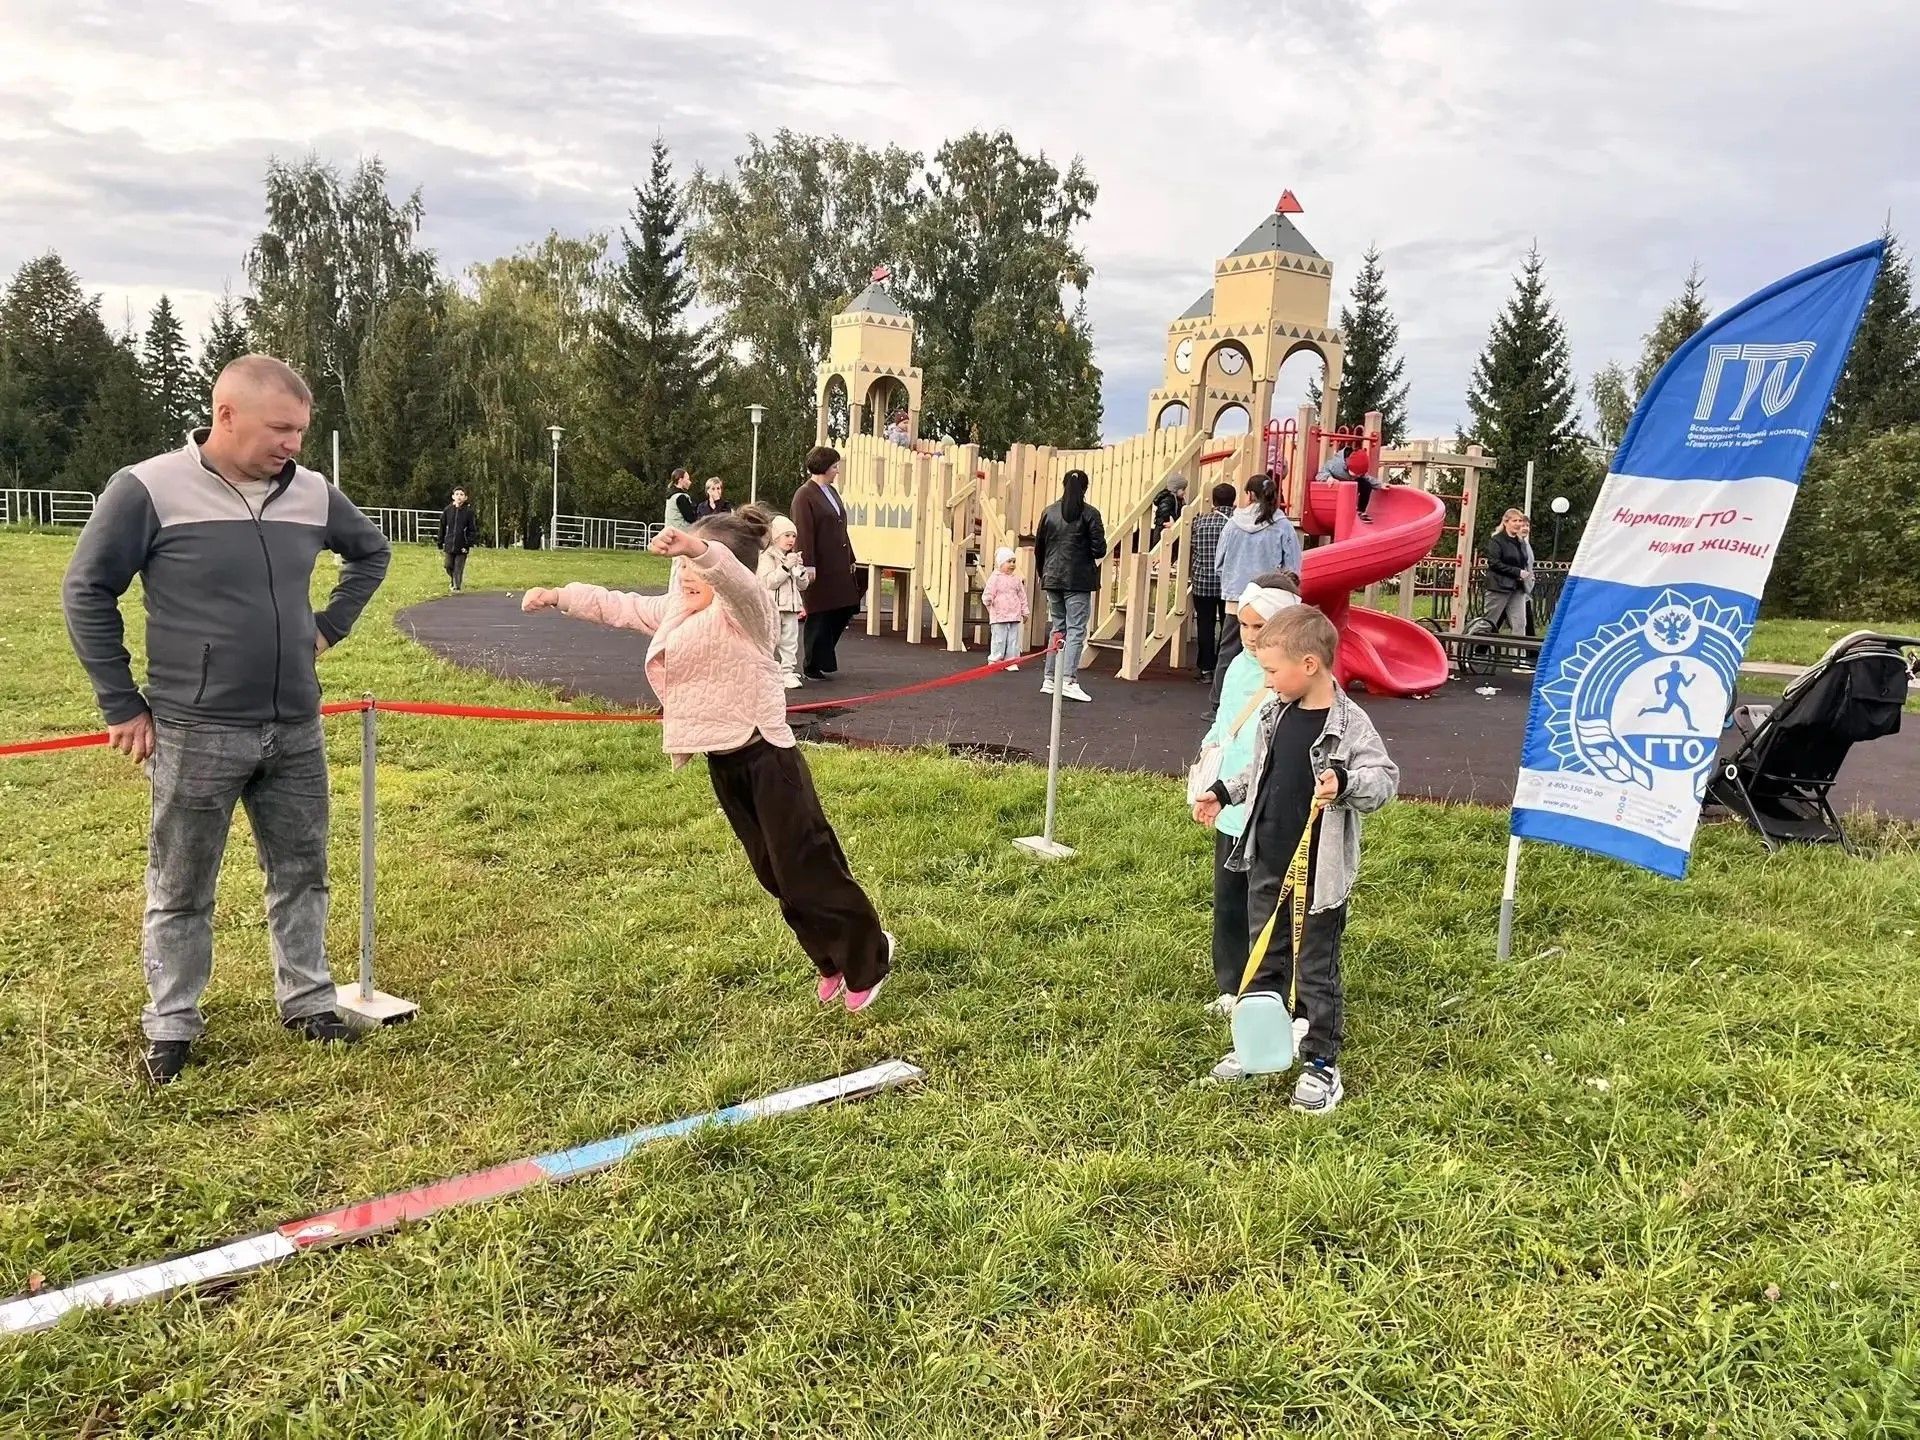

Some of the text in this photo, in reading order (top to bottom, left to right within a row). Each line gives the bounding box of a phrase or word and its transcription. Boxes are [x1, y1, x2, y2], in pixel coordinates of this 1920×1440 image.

[1694, 341, 1817, 420] ГТО
[1689, 424, 1741, 433] Всероский
[1695, 509, 1738, 529] ГТО
[1699, 538, 1770, 558] жизни!
[1644, 738, 1705, 763] ГТО
[1297, 865, 1307, 886] LOVE
[1295, 896, 1305, 916] LOVE
